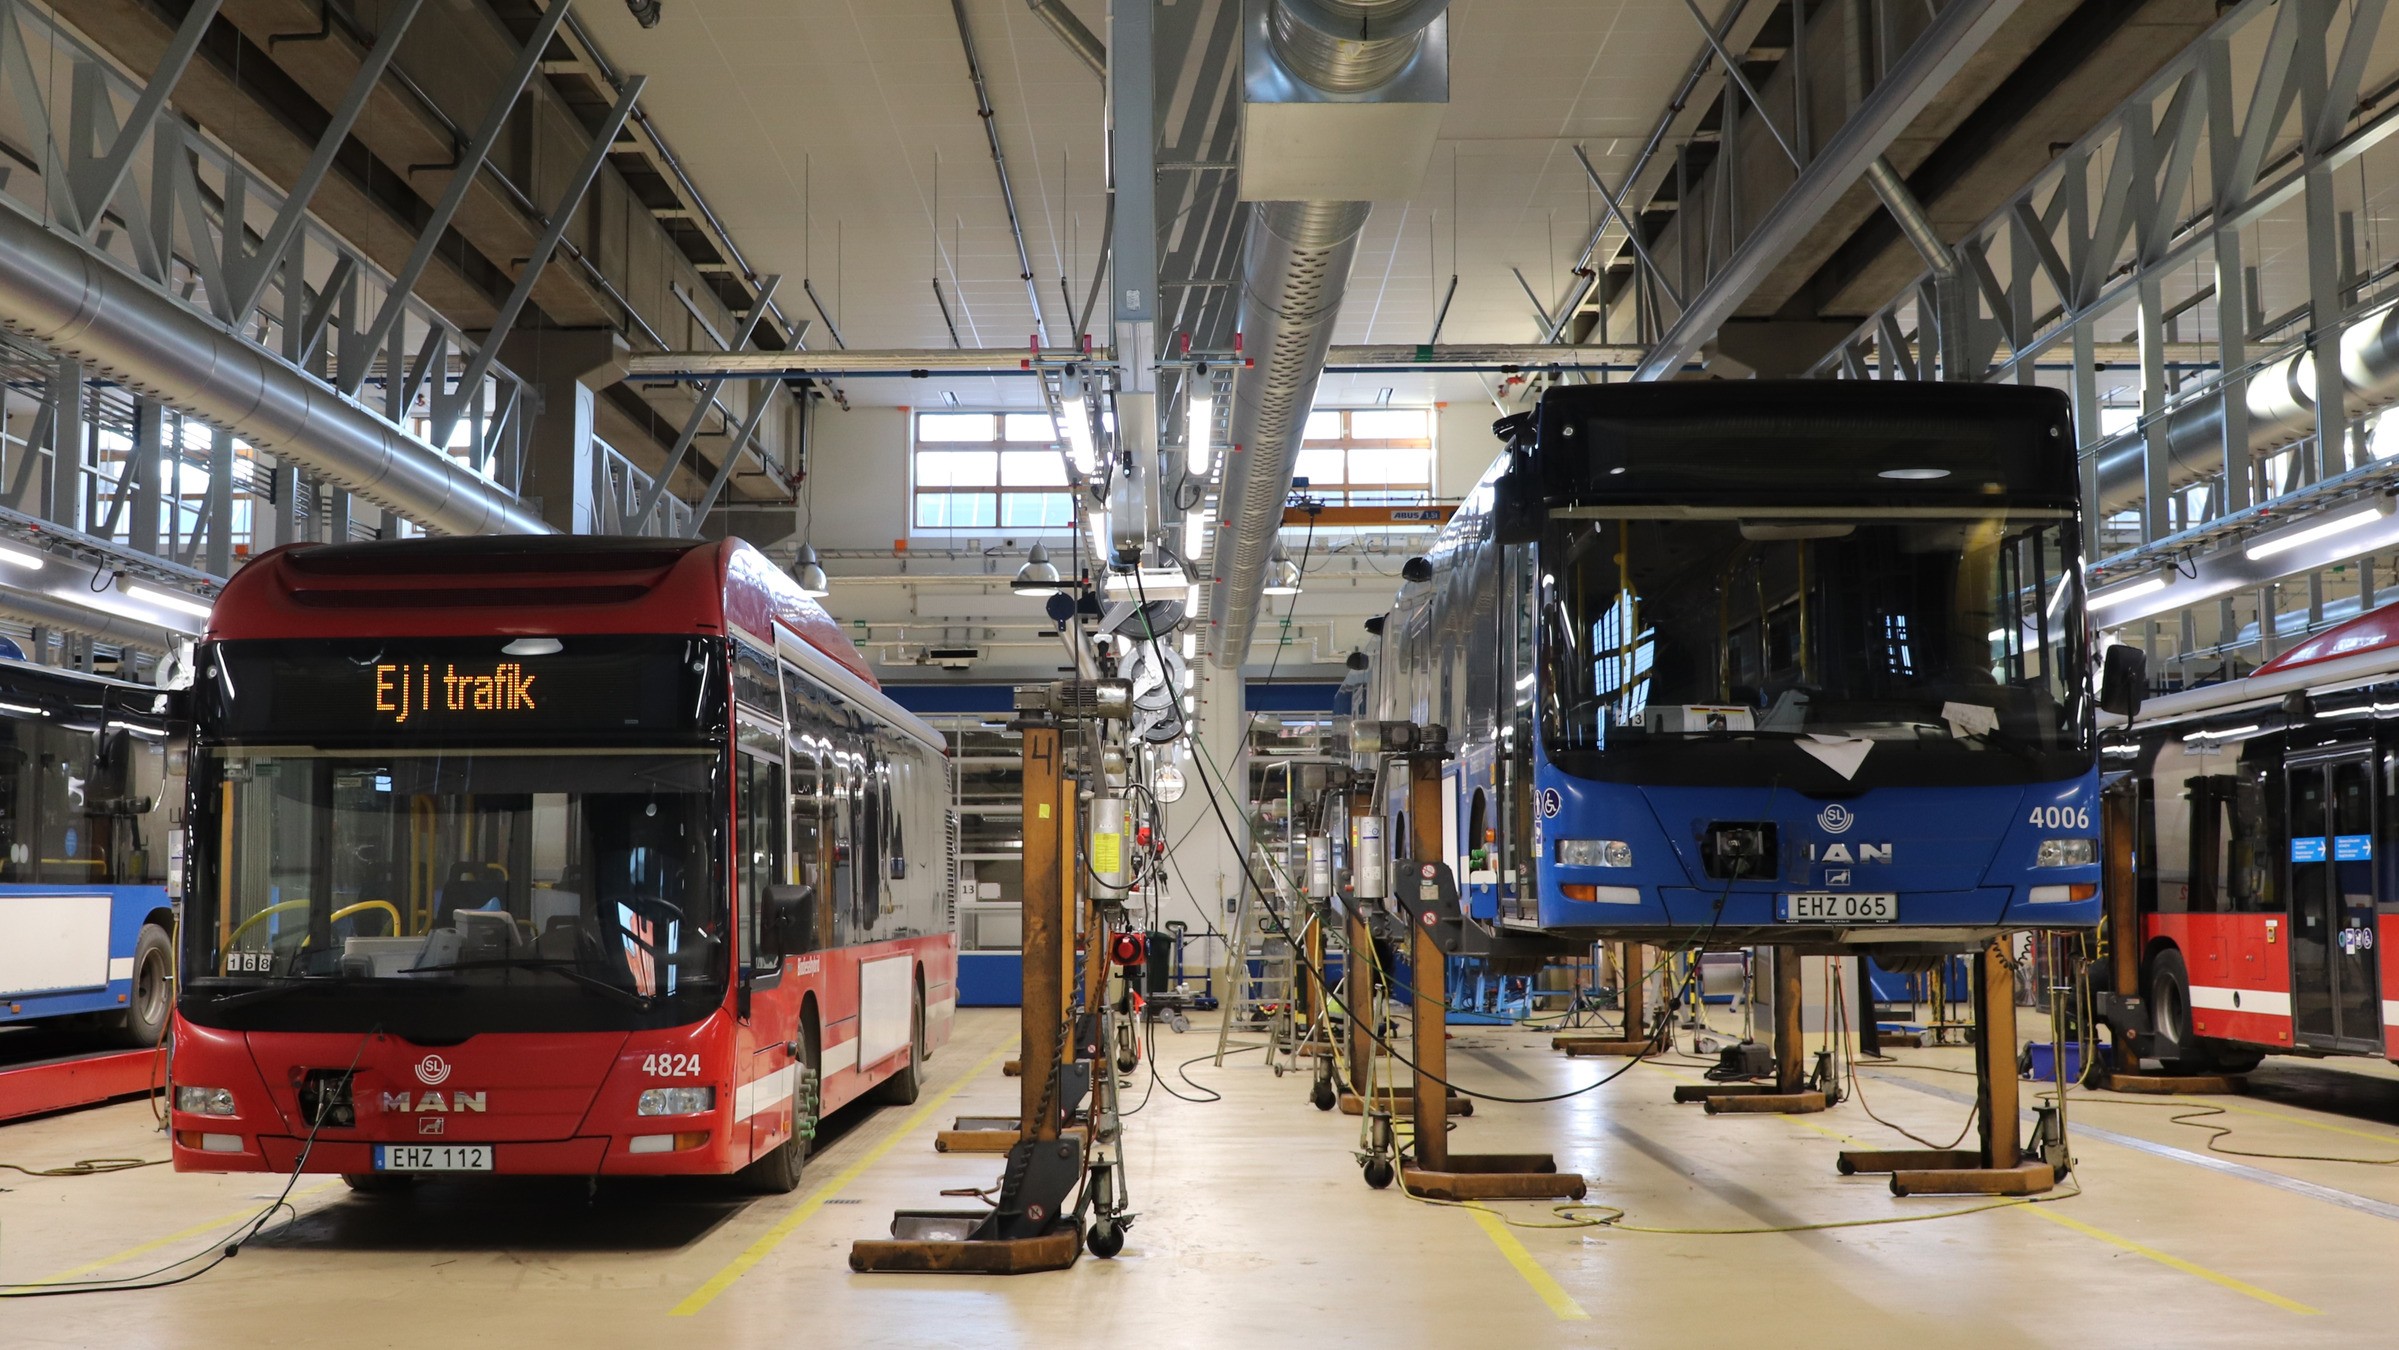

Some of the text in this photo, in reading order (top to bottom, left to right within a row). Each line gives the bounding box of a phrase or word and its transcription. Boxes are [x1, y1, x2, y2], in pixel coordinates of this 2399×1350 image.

[1393, 511, 1419, 519] ABUS
[376, 663, 536, 723] Ej i trafik
[1031, 735, 1053, 776] 4
[1826, 809, 1844, 821] SL
[2029, 806, 2089, 829] 4006
[962, 885, 975, 895] 13
[1797, 897, 1886, 916] EHZ 065
[229, 957, 270, 970] 168
[425, 1060, 441, 1072] SL
[642, 1053, 701, 1077] 4824
[382, 1091, 487, 1113] MAN
[393, 1148, 483, 1168] EHZ 112
